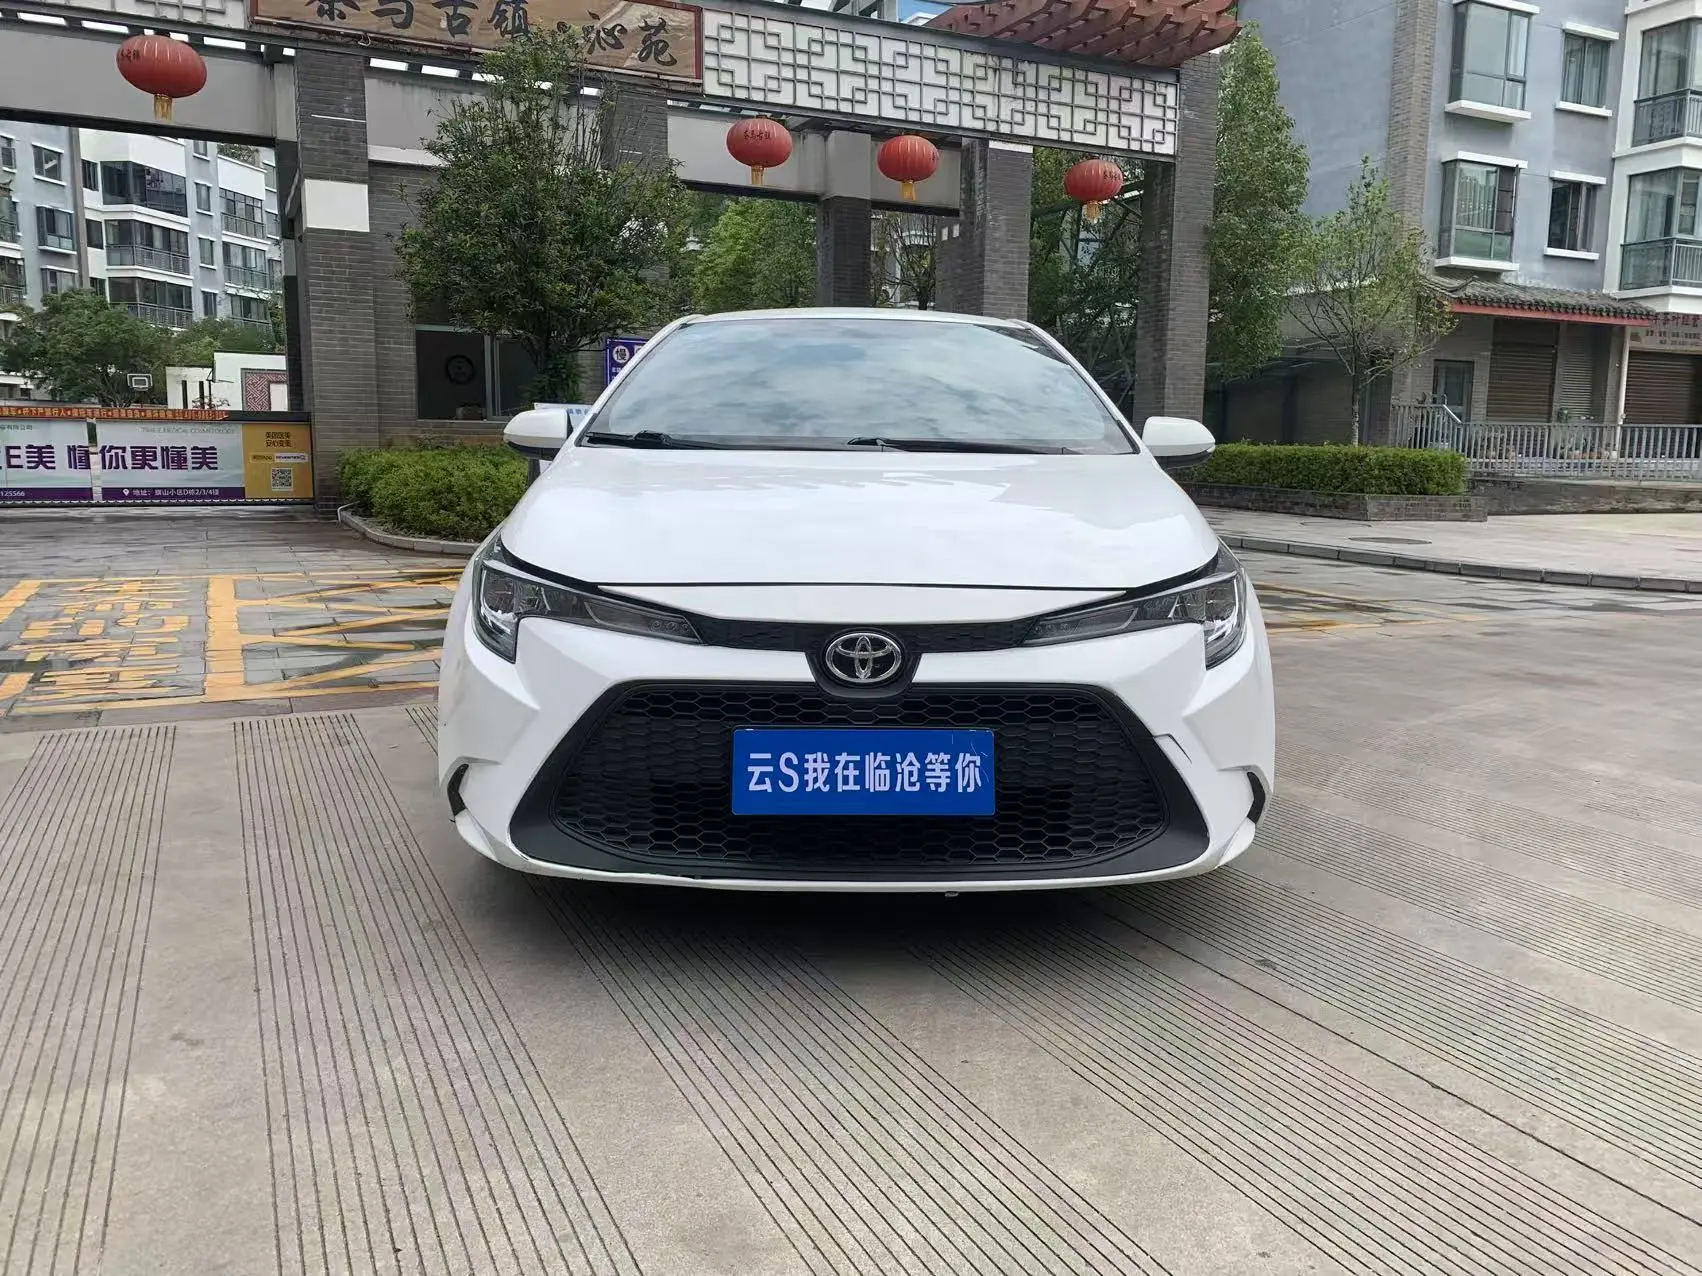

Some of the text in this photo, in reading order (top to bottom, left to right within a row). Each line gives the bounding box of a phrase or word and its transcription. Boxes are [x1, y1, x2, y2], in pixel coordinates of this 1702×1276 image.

[616, 348, 627, 361] 慢
[747, 751, 982, 793] 云S我在临沧等你
